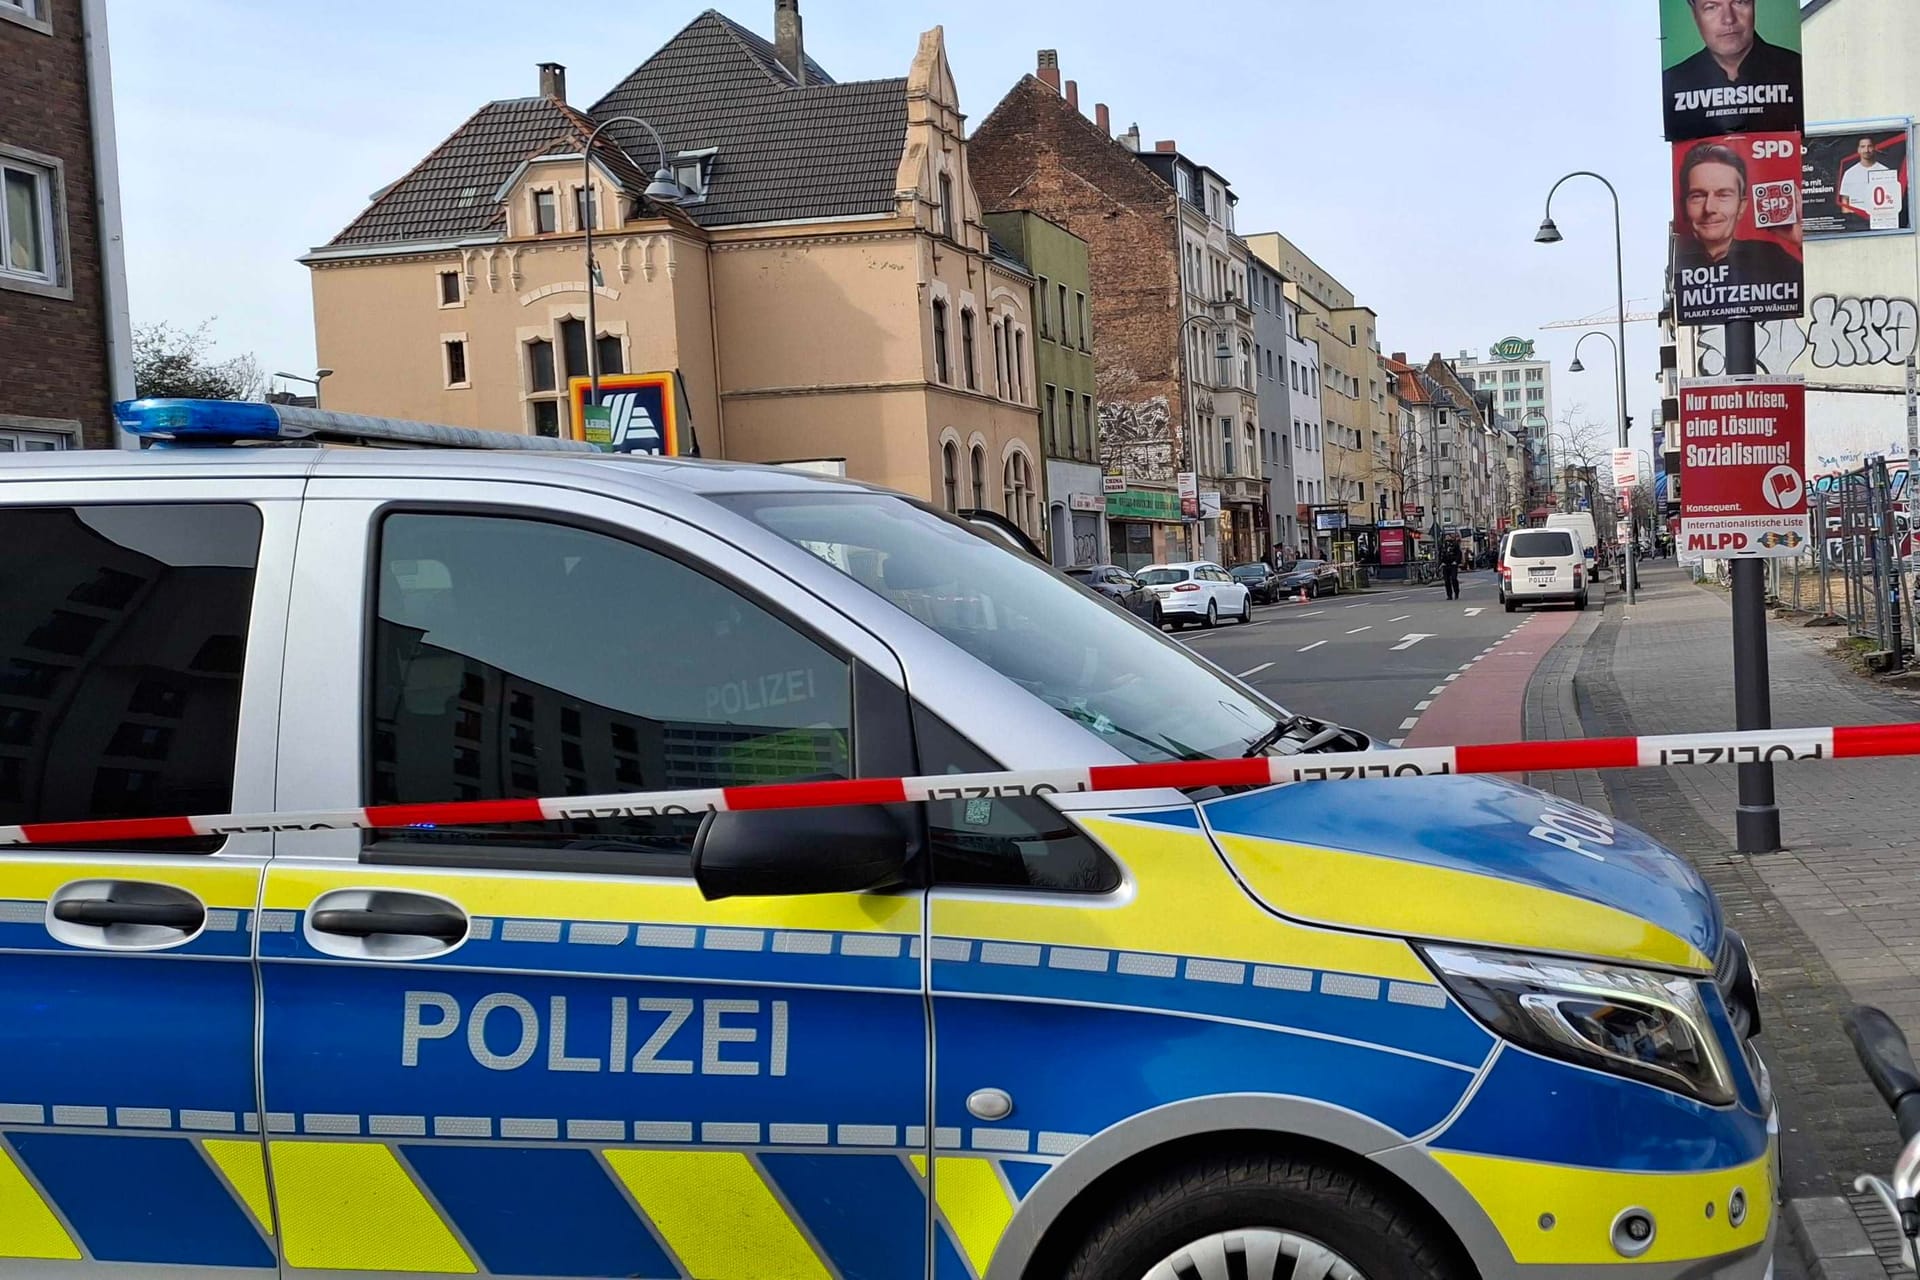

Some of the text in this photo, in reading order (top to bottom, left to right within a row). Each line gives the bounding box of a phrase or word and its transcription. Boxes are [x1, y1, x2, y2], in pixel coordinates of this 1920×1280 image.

[1674, 84, 1794, 111] ZUVERSICHT.
[1752, 140, 1794, 159] SPD
[1761, 197, 1789, 211] SPD
[1681, 265, 1729, 286] ROLF
[1682, 282, 1798, 307] MÜTZENICH
[1684, 309, 1710, 319] PLAKAT
[1712, 306, 1749, 316] SCANNEN,
[1765, 303, 1798, 313] WÄHLEN!
[1685, 391, 1788, 411] Nur noch Krisen,
[1686, 415, 1777, 438] eine Lösung:
[1686, 441, 1791, 467] Sozialismus!
[1686, 503, 1742, 513] Konsequent.
[1687, 518, 1804, 529] Internationalistische Liste
[1688, 532, 1748, 551] MLPD
[704, 668, 815, 719] POLIZEI
[402, 990, 788, 1077] POLIZEI
